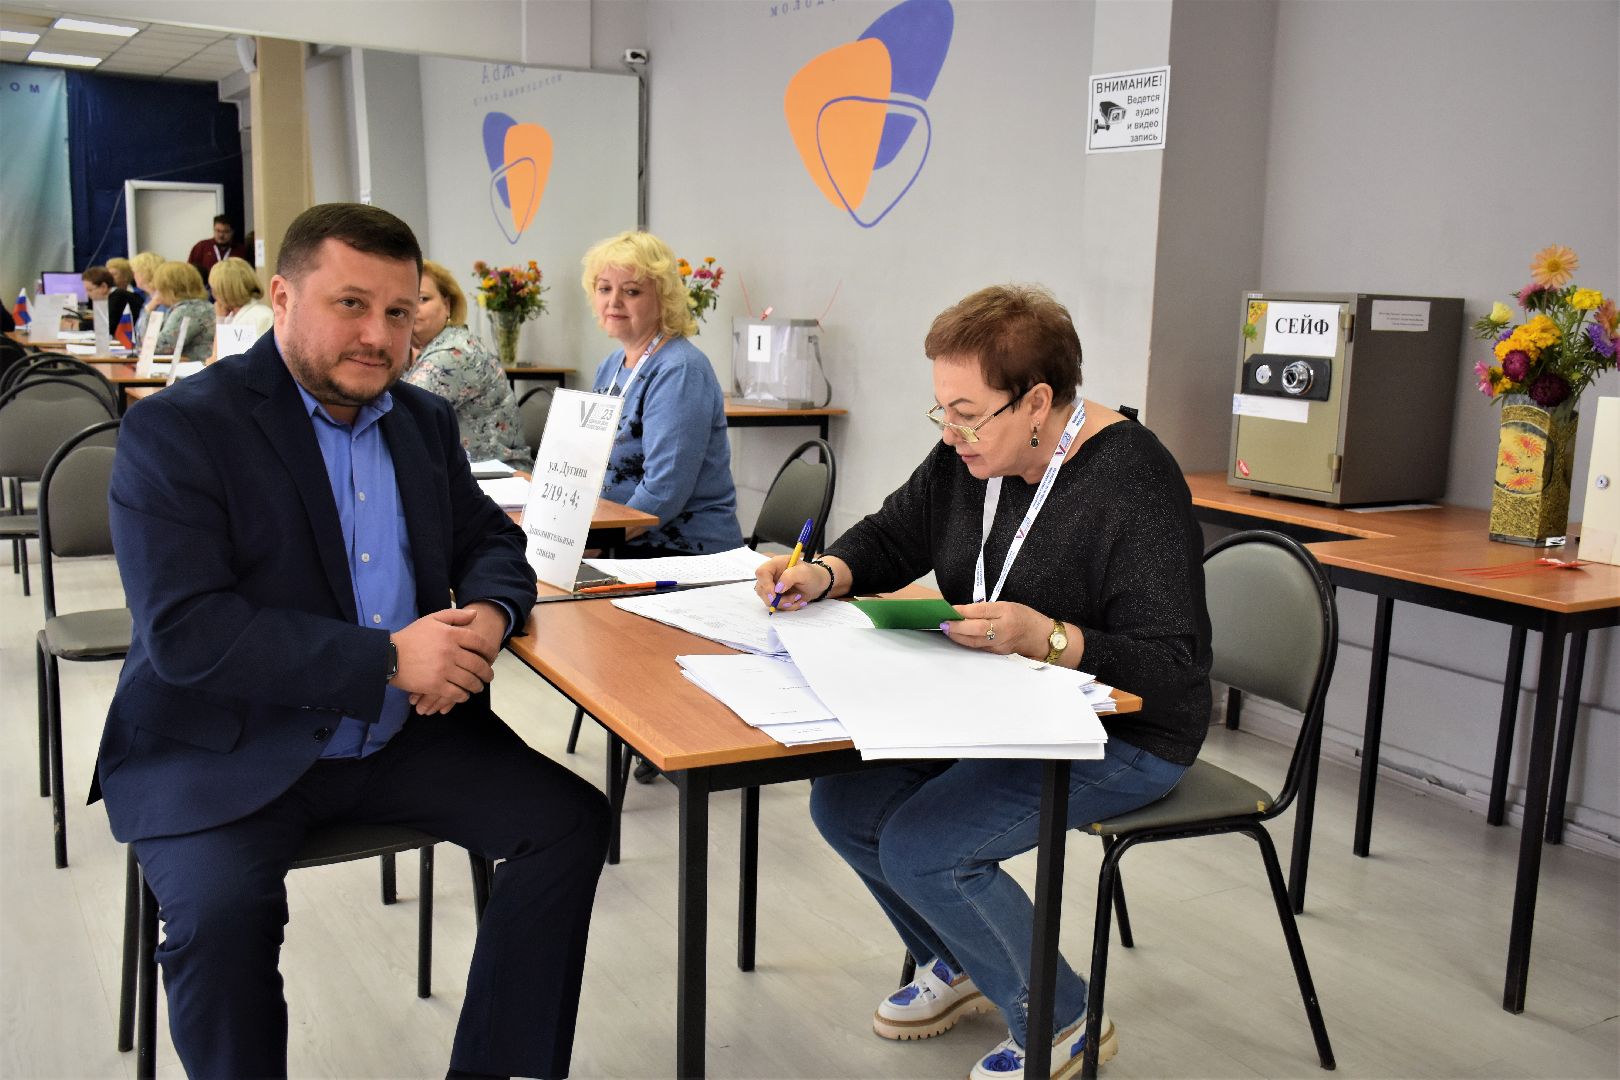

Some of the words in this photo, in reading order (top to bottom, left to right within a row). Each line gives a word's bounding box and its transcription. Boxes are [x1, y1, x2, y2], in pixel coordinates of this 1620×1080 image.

[1096, 75, 1163, 94] ВНИМАНИЕ!
[1127, 94, 1160, 105] Ведется
[1135, 107, 1159, 118] аудио
[1134, 120, 1159, 130] видео
[1130, 133, 1158, 143] запись
[1275, 314, 1329, 335] СЕЙФ
[757, 335, 762, 351] 1
[547, 461, 559, 474] ул.
[541, 482, 563, 502] 2/19
